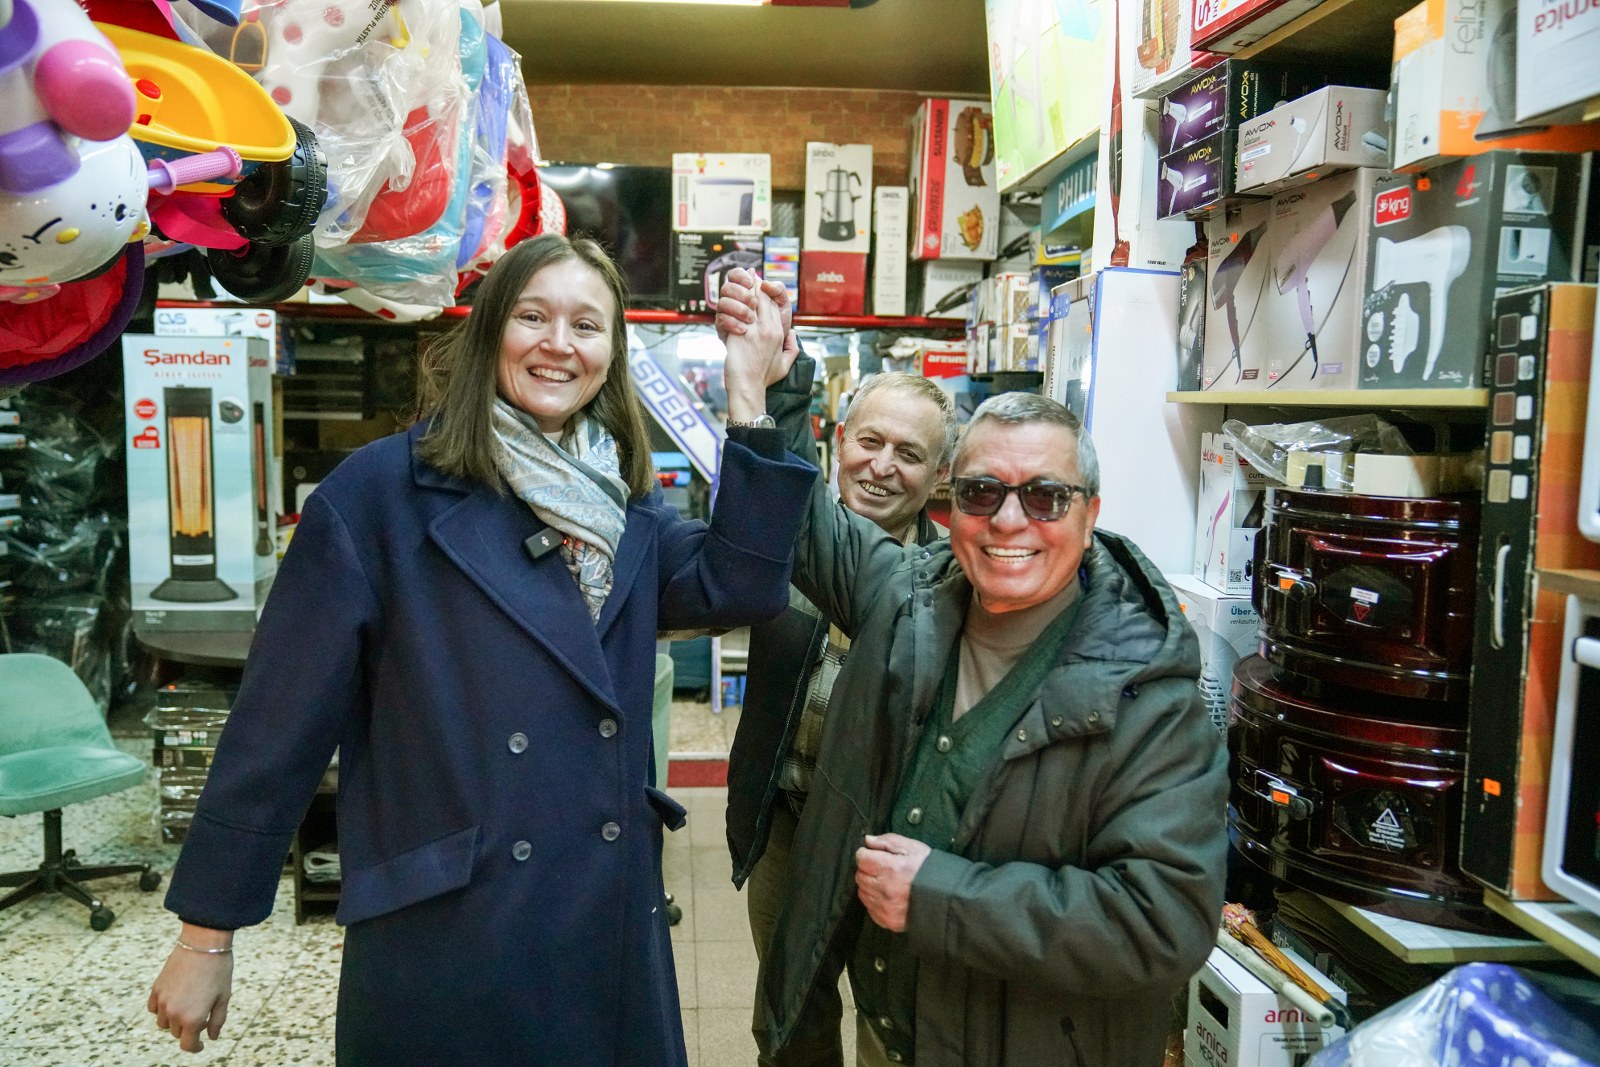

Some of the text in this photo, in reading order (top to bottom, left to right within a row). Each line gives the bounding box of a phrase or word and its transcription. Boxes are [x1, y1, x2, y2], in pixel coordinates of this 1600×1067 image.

[1191, 76, 1215, 96] AWOX
[1240, 73, 1249, 118] AWOX
[1244, 121, 1274, 138] AWOX
[1334, 104, 1343, 150] AWOX
[1188, 148, 1211, 163] AWOX
[1276, 193, 1304, 207] AWOX
[1388, 197, 1409, 216] king
[143, 349, 231, 366] Şamdan
[1231, 606, 1252, 616] Über
[1196, 1021, 1228, 1065] arnica
